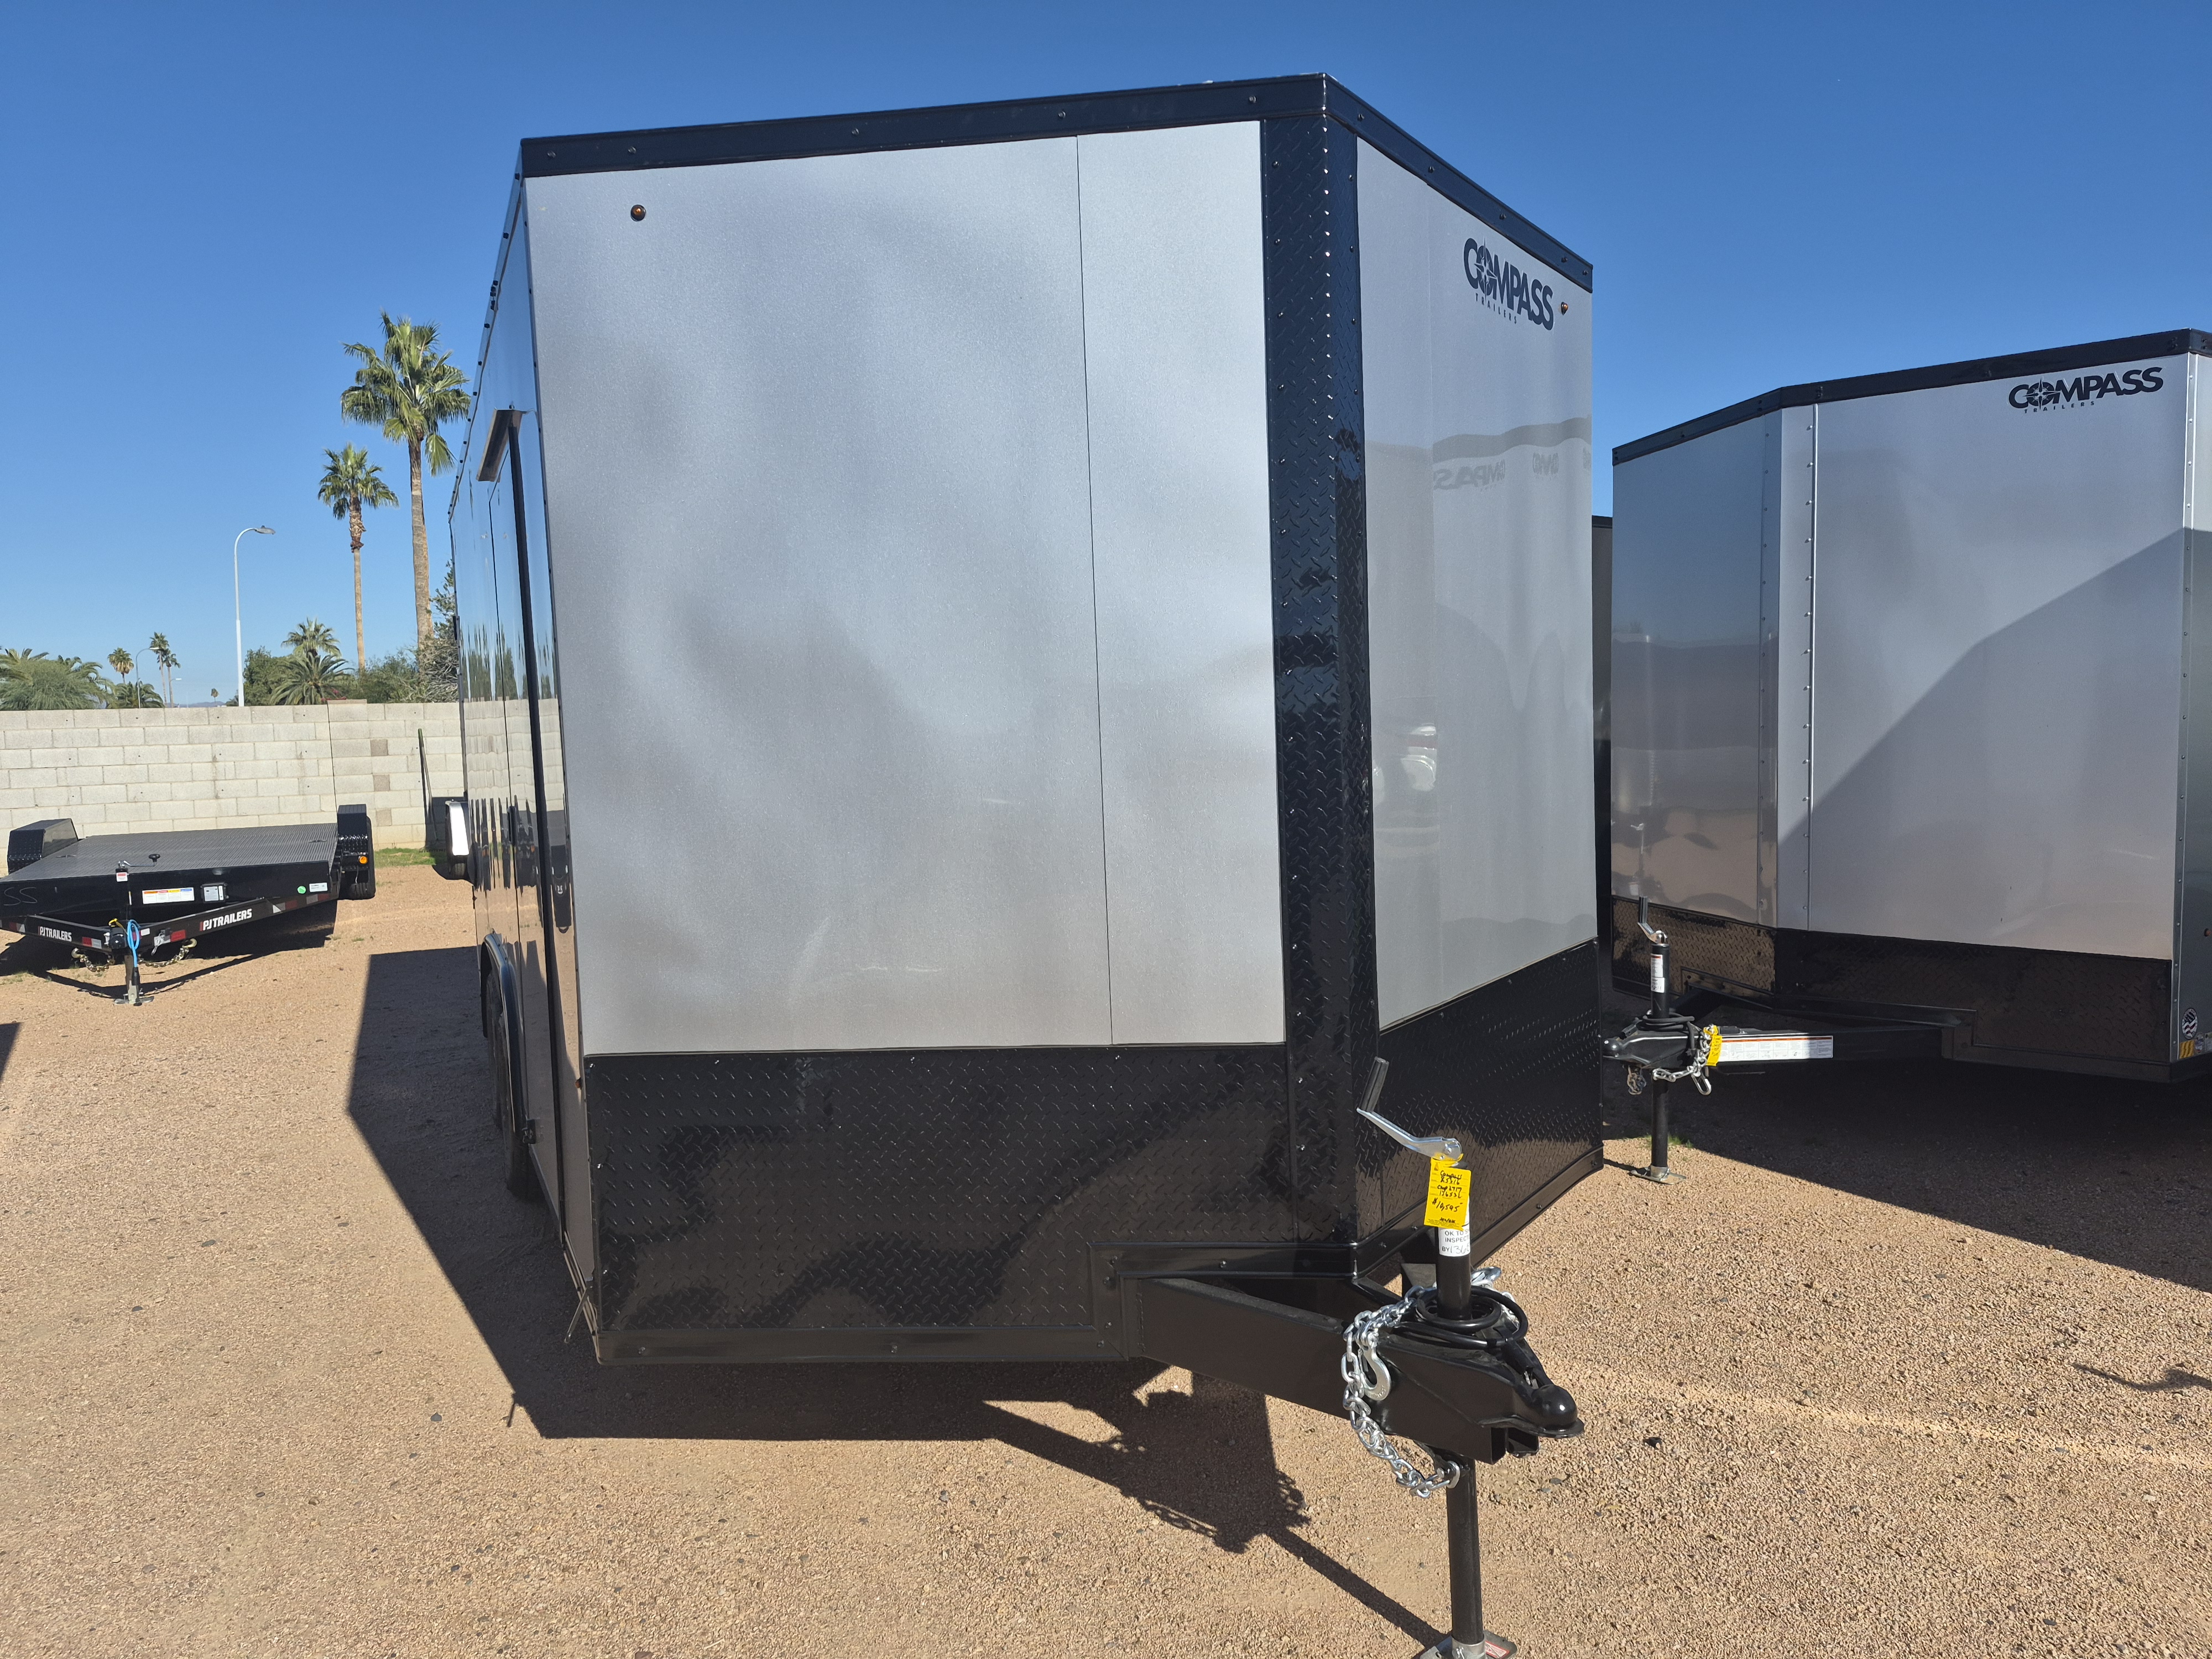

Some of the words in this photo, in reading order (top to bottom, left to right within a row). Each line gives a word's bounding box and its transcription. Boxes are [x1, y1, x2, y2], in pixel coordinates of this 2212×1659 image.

[1464, 237, 1554, 331] COMPASS
[1475, 293, 1517, 324] TRAILERS
[2008, 367, 2164, 409] COMPASS
[2024, 400, 2095, 414] TRAILERS
